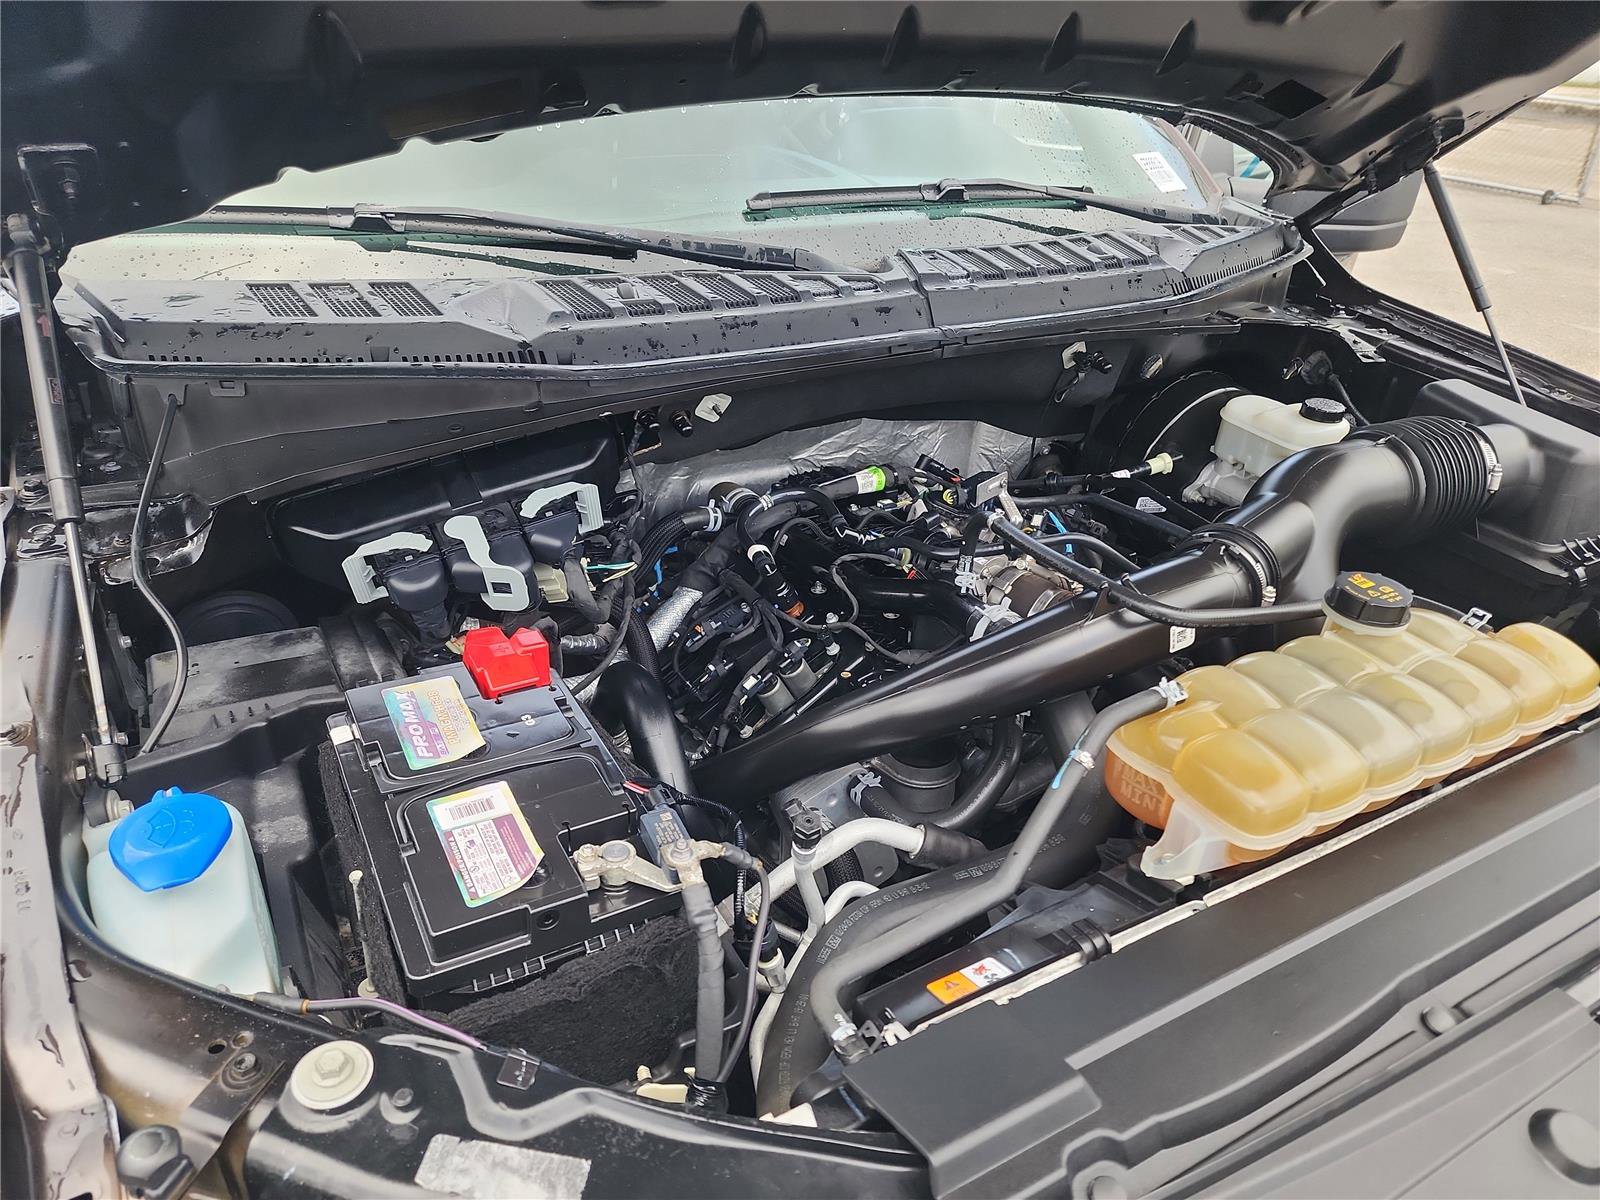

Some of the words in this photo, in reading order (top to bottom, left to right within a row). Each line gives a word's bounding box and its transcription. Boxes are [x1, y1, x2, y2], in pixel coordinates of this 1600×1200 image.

[394, 691, 420, 723] MAX
[408, 724, 433, 757] PRO
[1120, 780, 1158, 811] MIN
